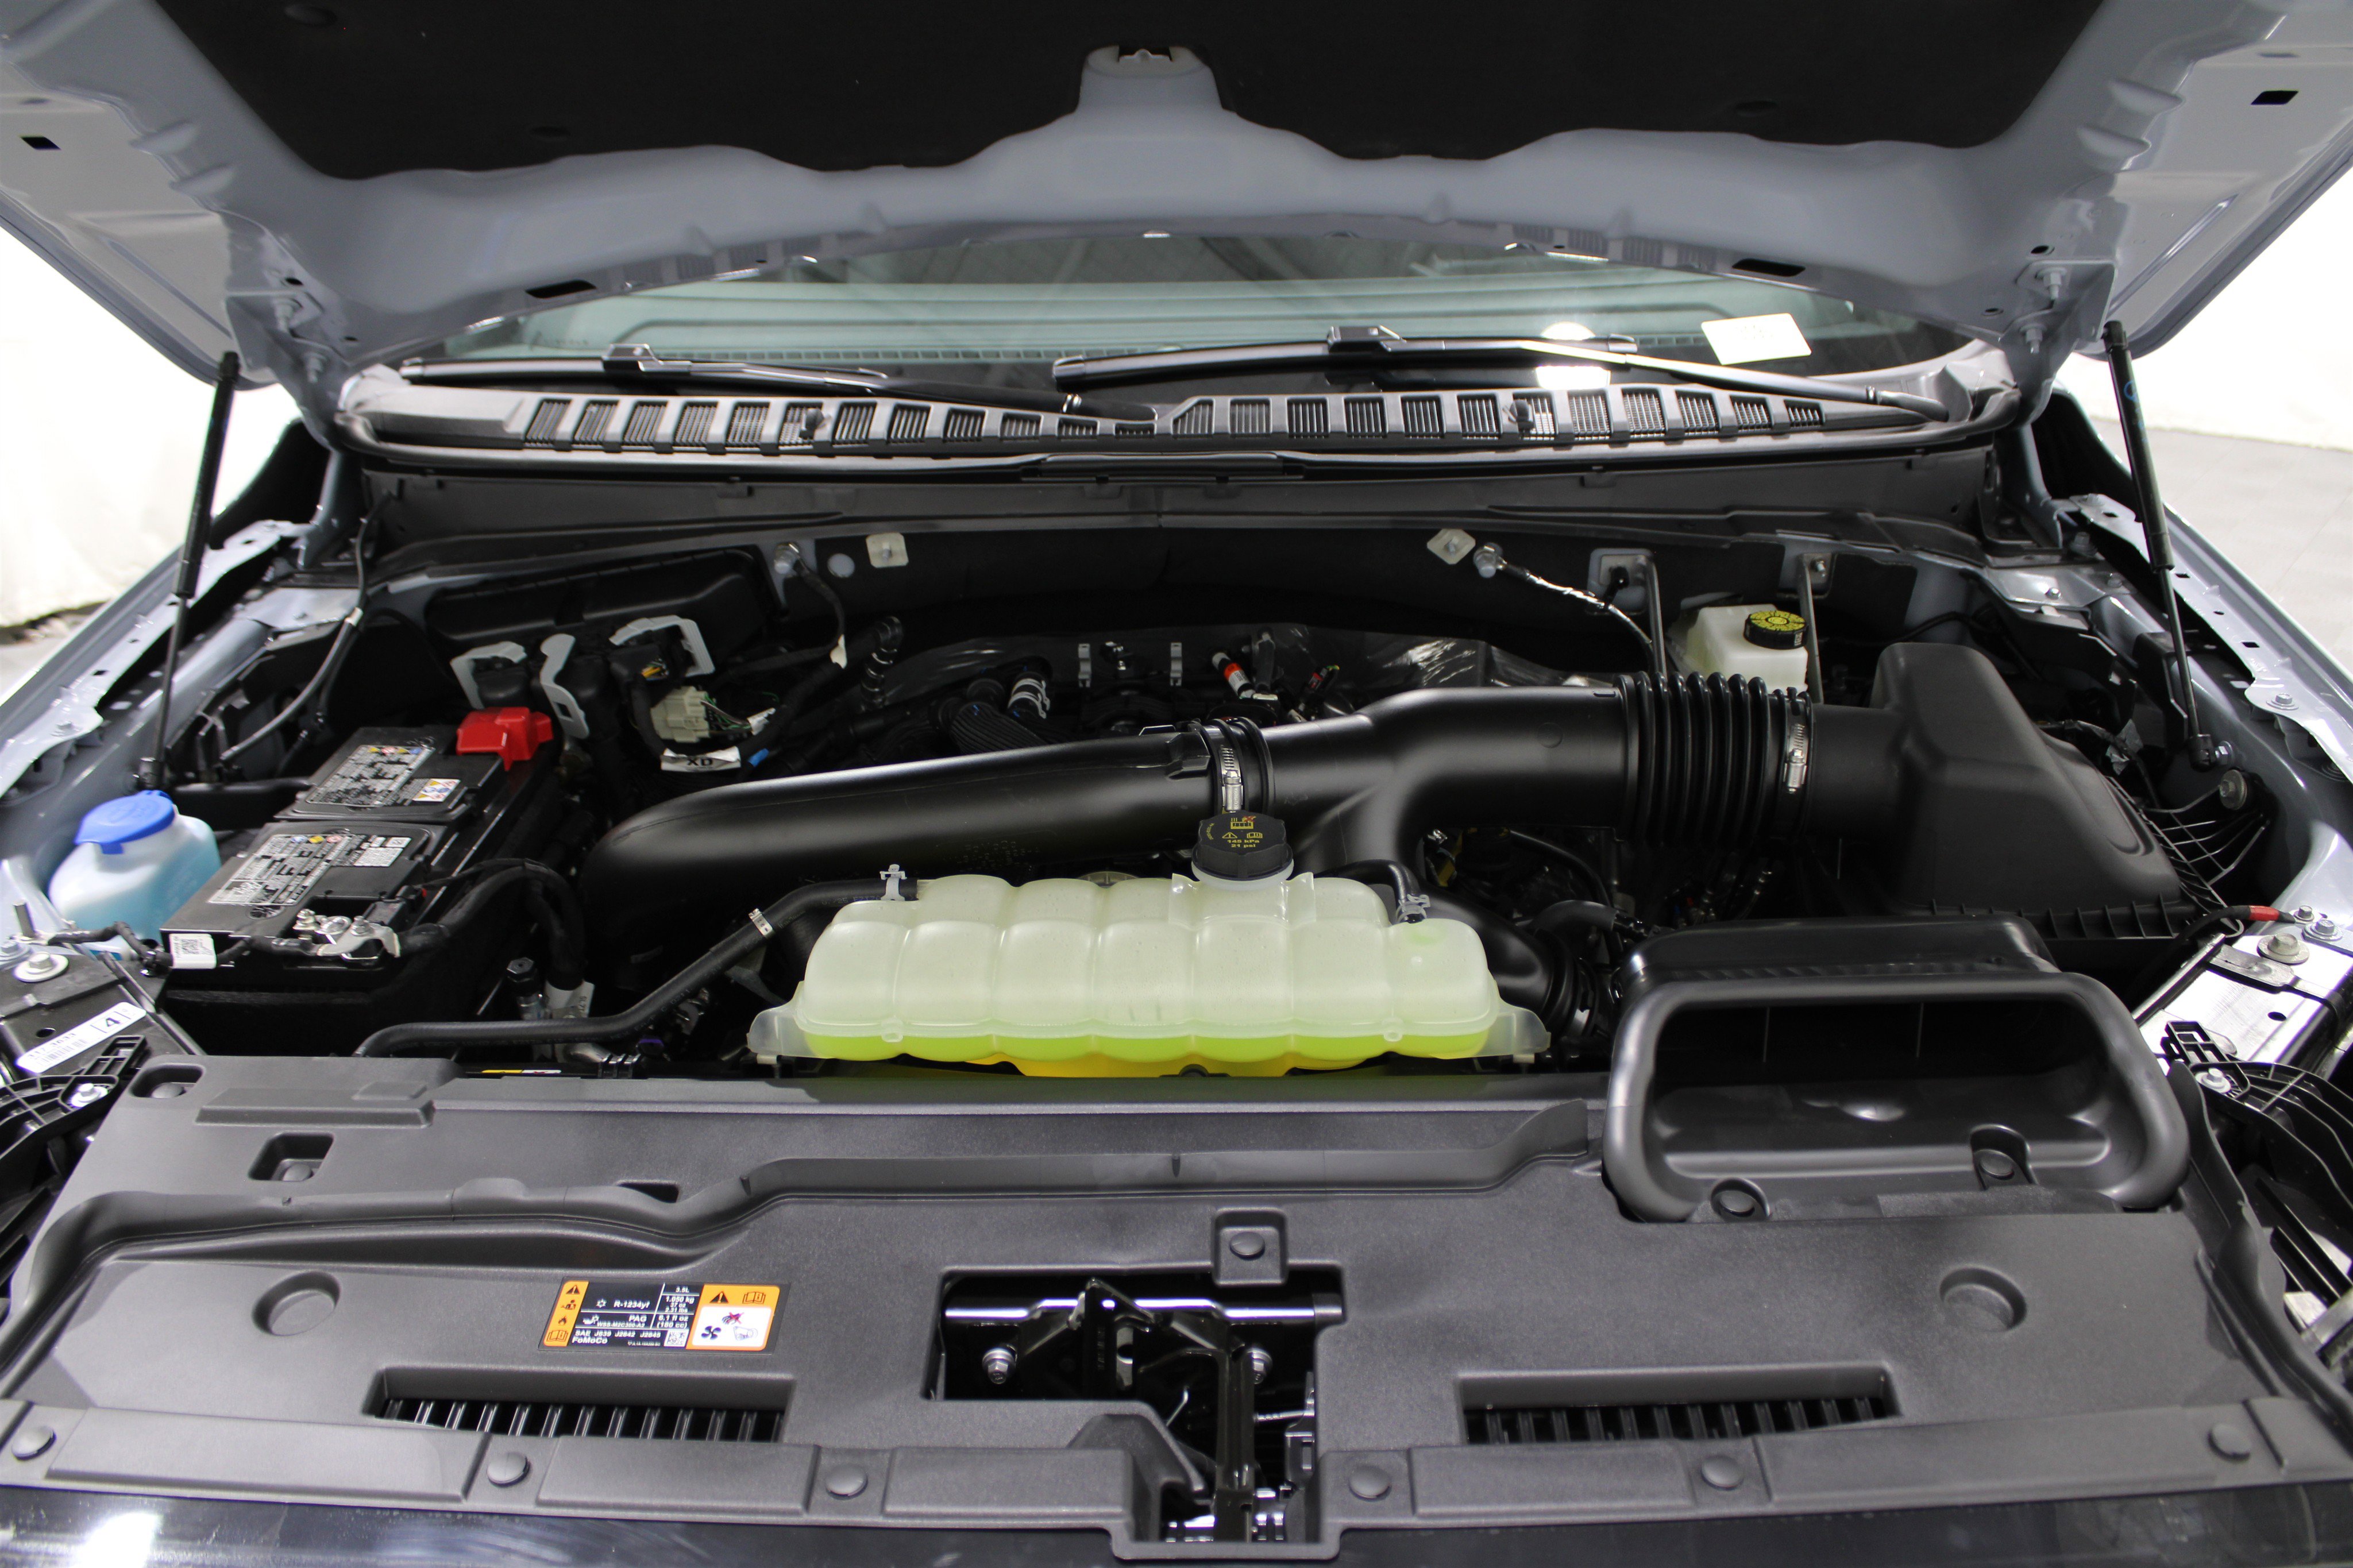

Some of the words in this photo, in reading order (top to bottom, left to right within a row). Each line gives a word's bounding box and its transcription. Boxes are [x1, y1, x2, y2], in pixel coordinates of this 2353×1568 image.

[686, 758, 713, 766] XD
[105, 1017, 121, 1028] 4
[614, 1300, 650, 1310] R-1234yf
